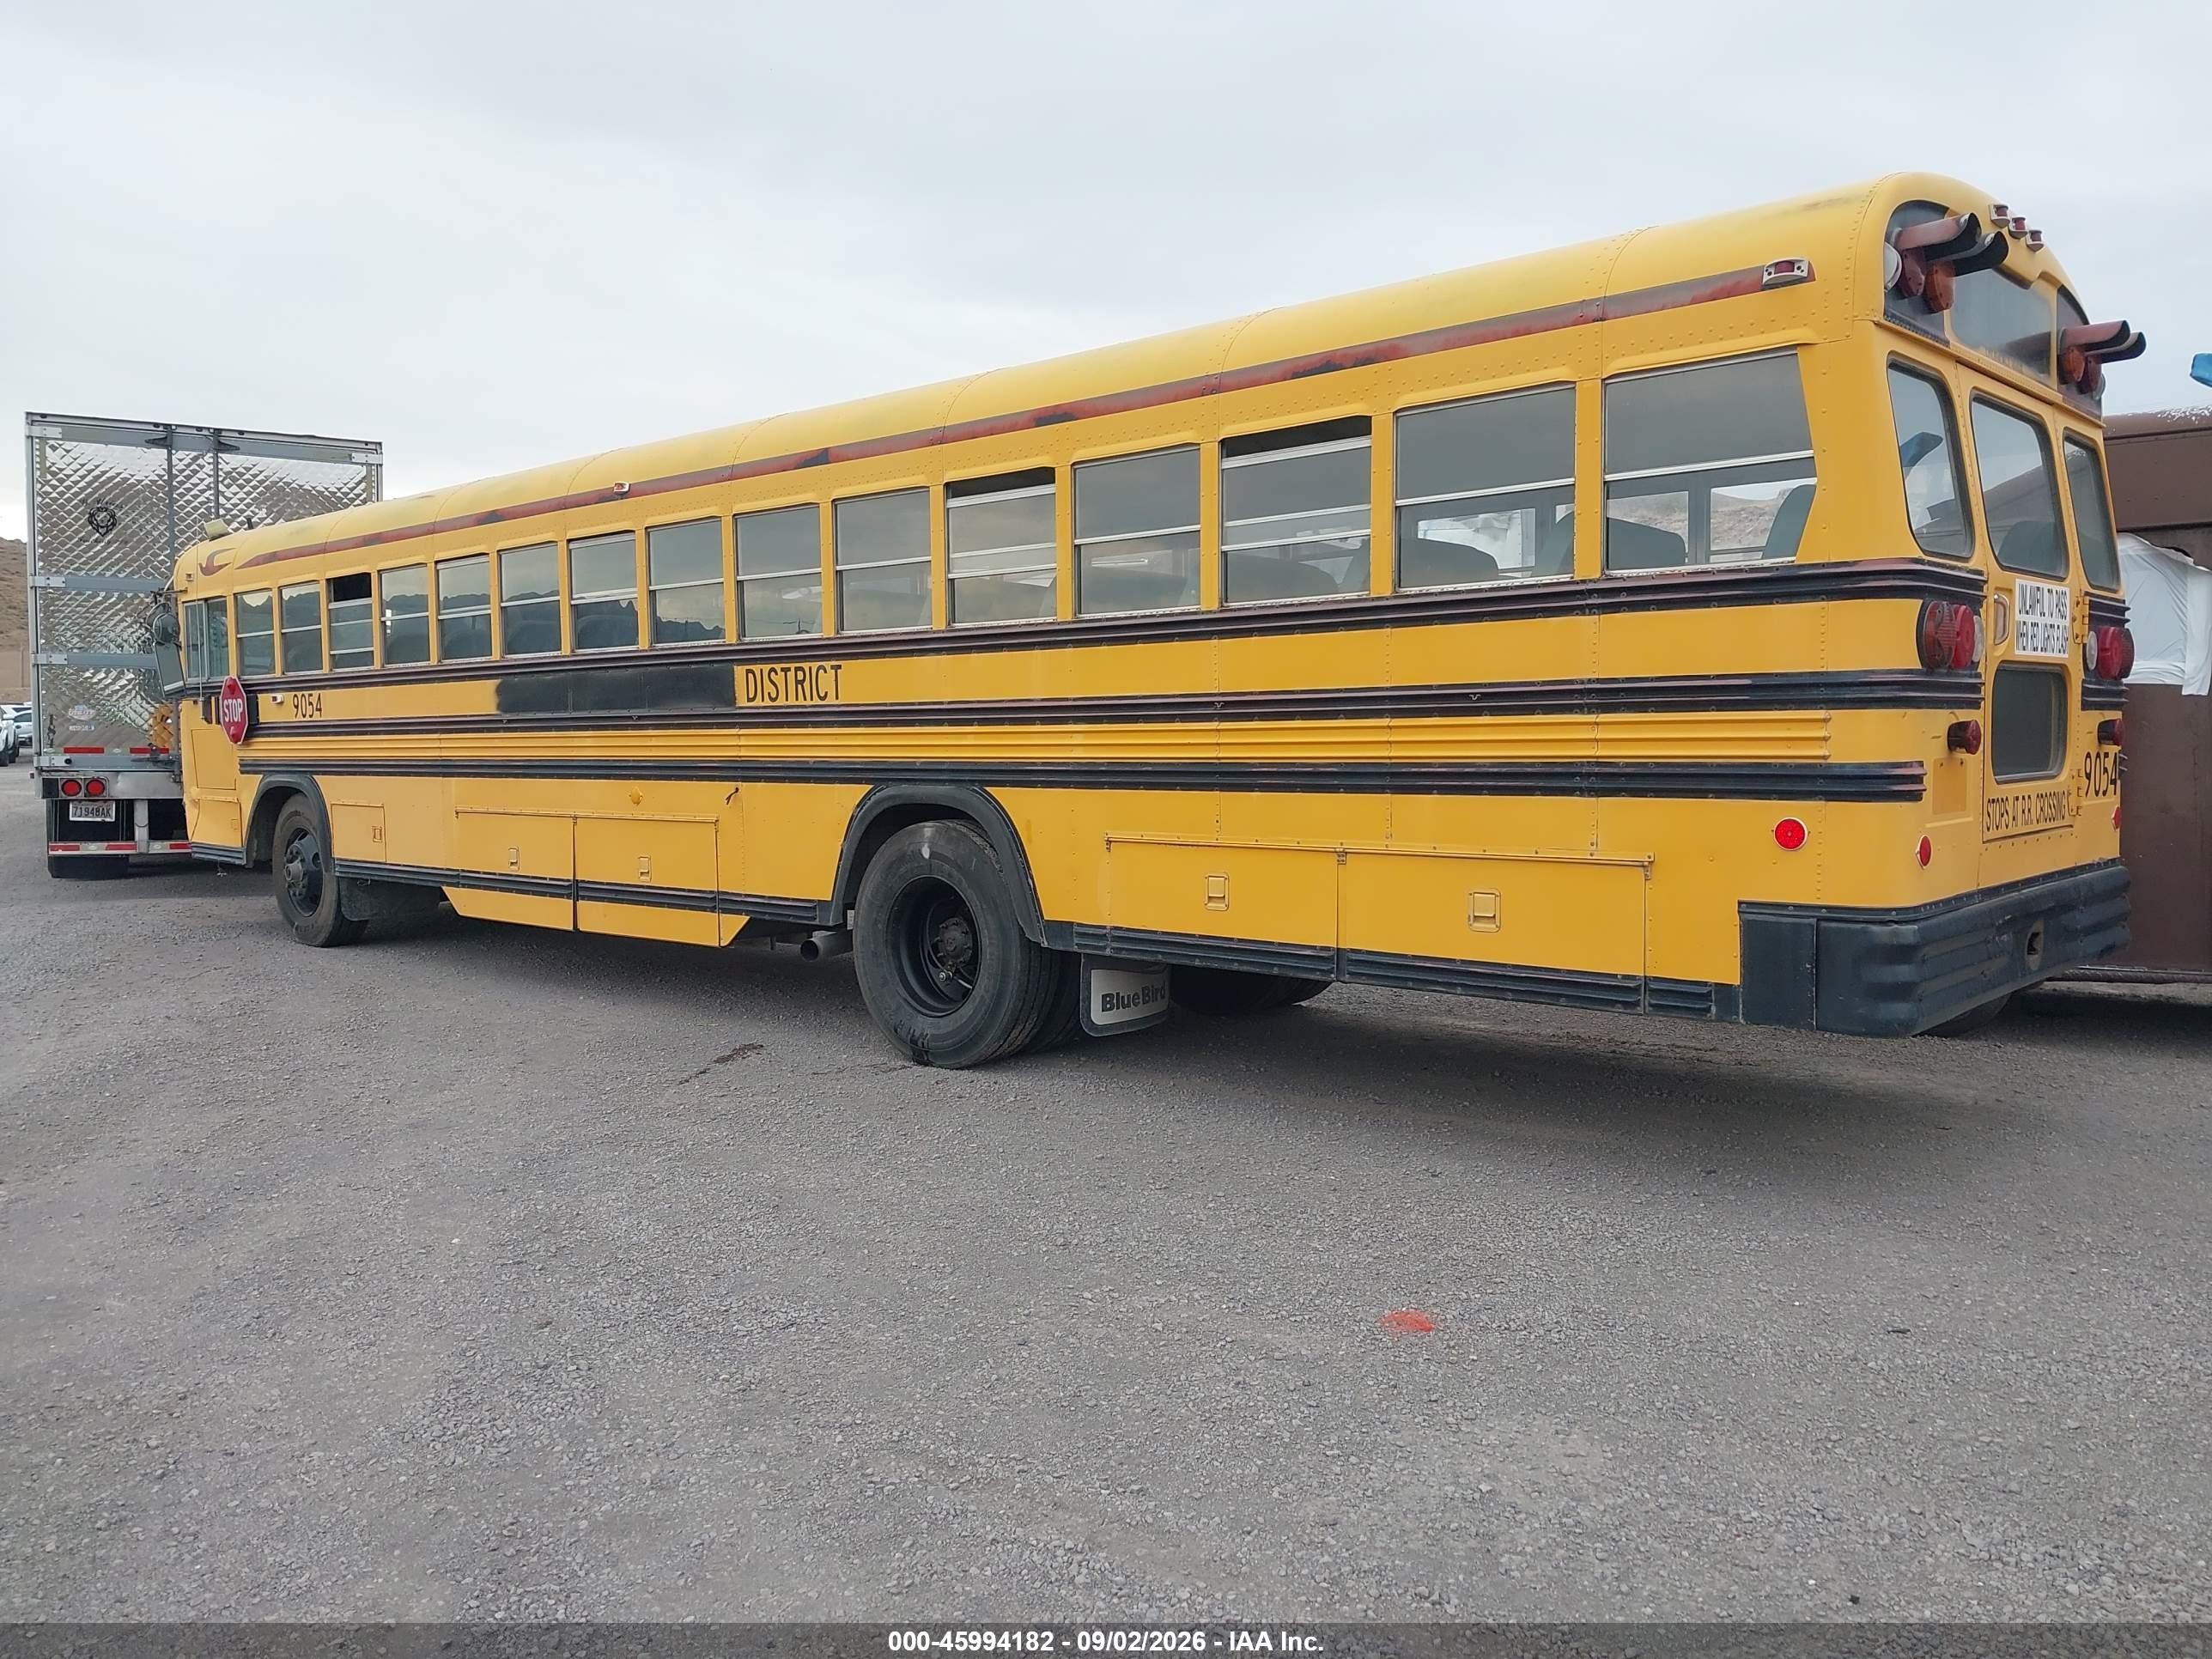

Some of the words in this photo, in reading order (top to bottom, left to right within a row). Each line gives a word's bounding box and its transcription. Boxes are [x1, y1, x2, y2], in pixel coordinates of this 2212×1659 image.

[2018, 583, 2045, 617] UNLAWFUL
[2047, 587, 2054, 618] TO
[2055, 589, 2068, 621] PASS
[2015, 620, 2029, 652] WHEN
[2030, 621, 2039, 653] RED
[2040, 622, 2056, 653] LIGHTS
[744, 664, 842, 703] DISTRICT
[223, 698, 243, 722] STOP
[292, 692, 323, 720] 9054
[2084, 750, 2118, 798] 9054
[1985, 795, 2009, 832] STOPS
[2011, 794, 2020, 828] AT
[2021, 793, 2033, 826] R.R.
[2035, 789, 2066, 824] CROSSING
